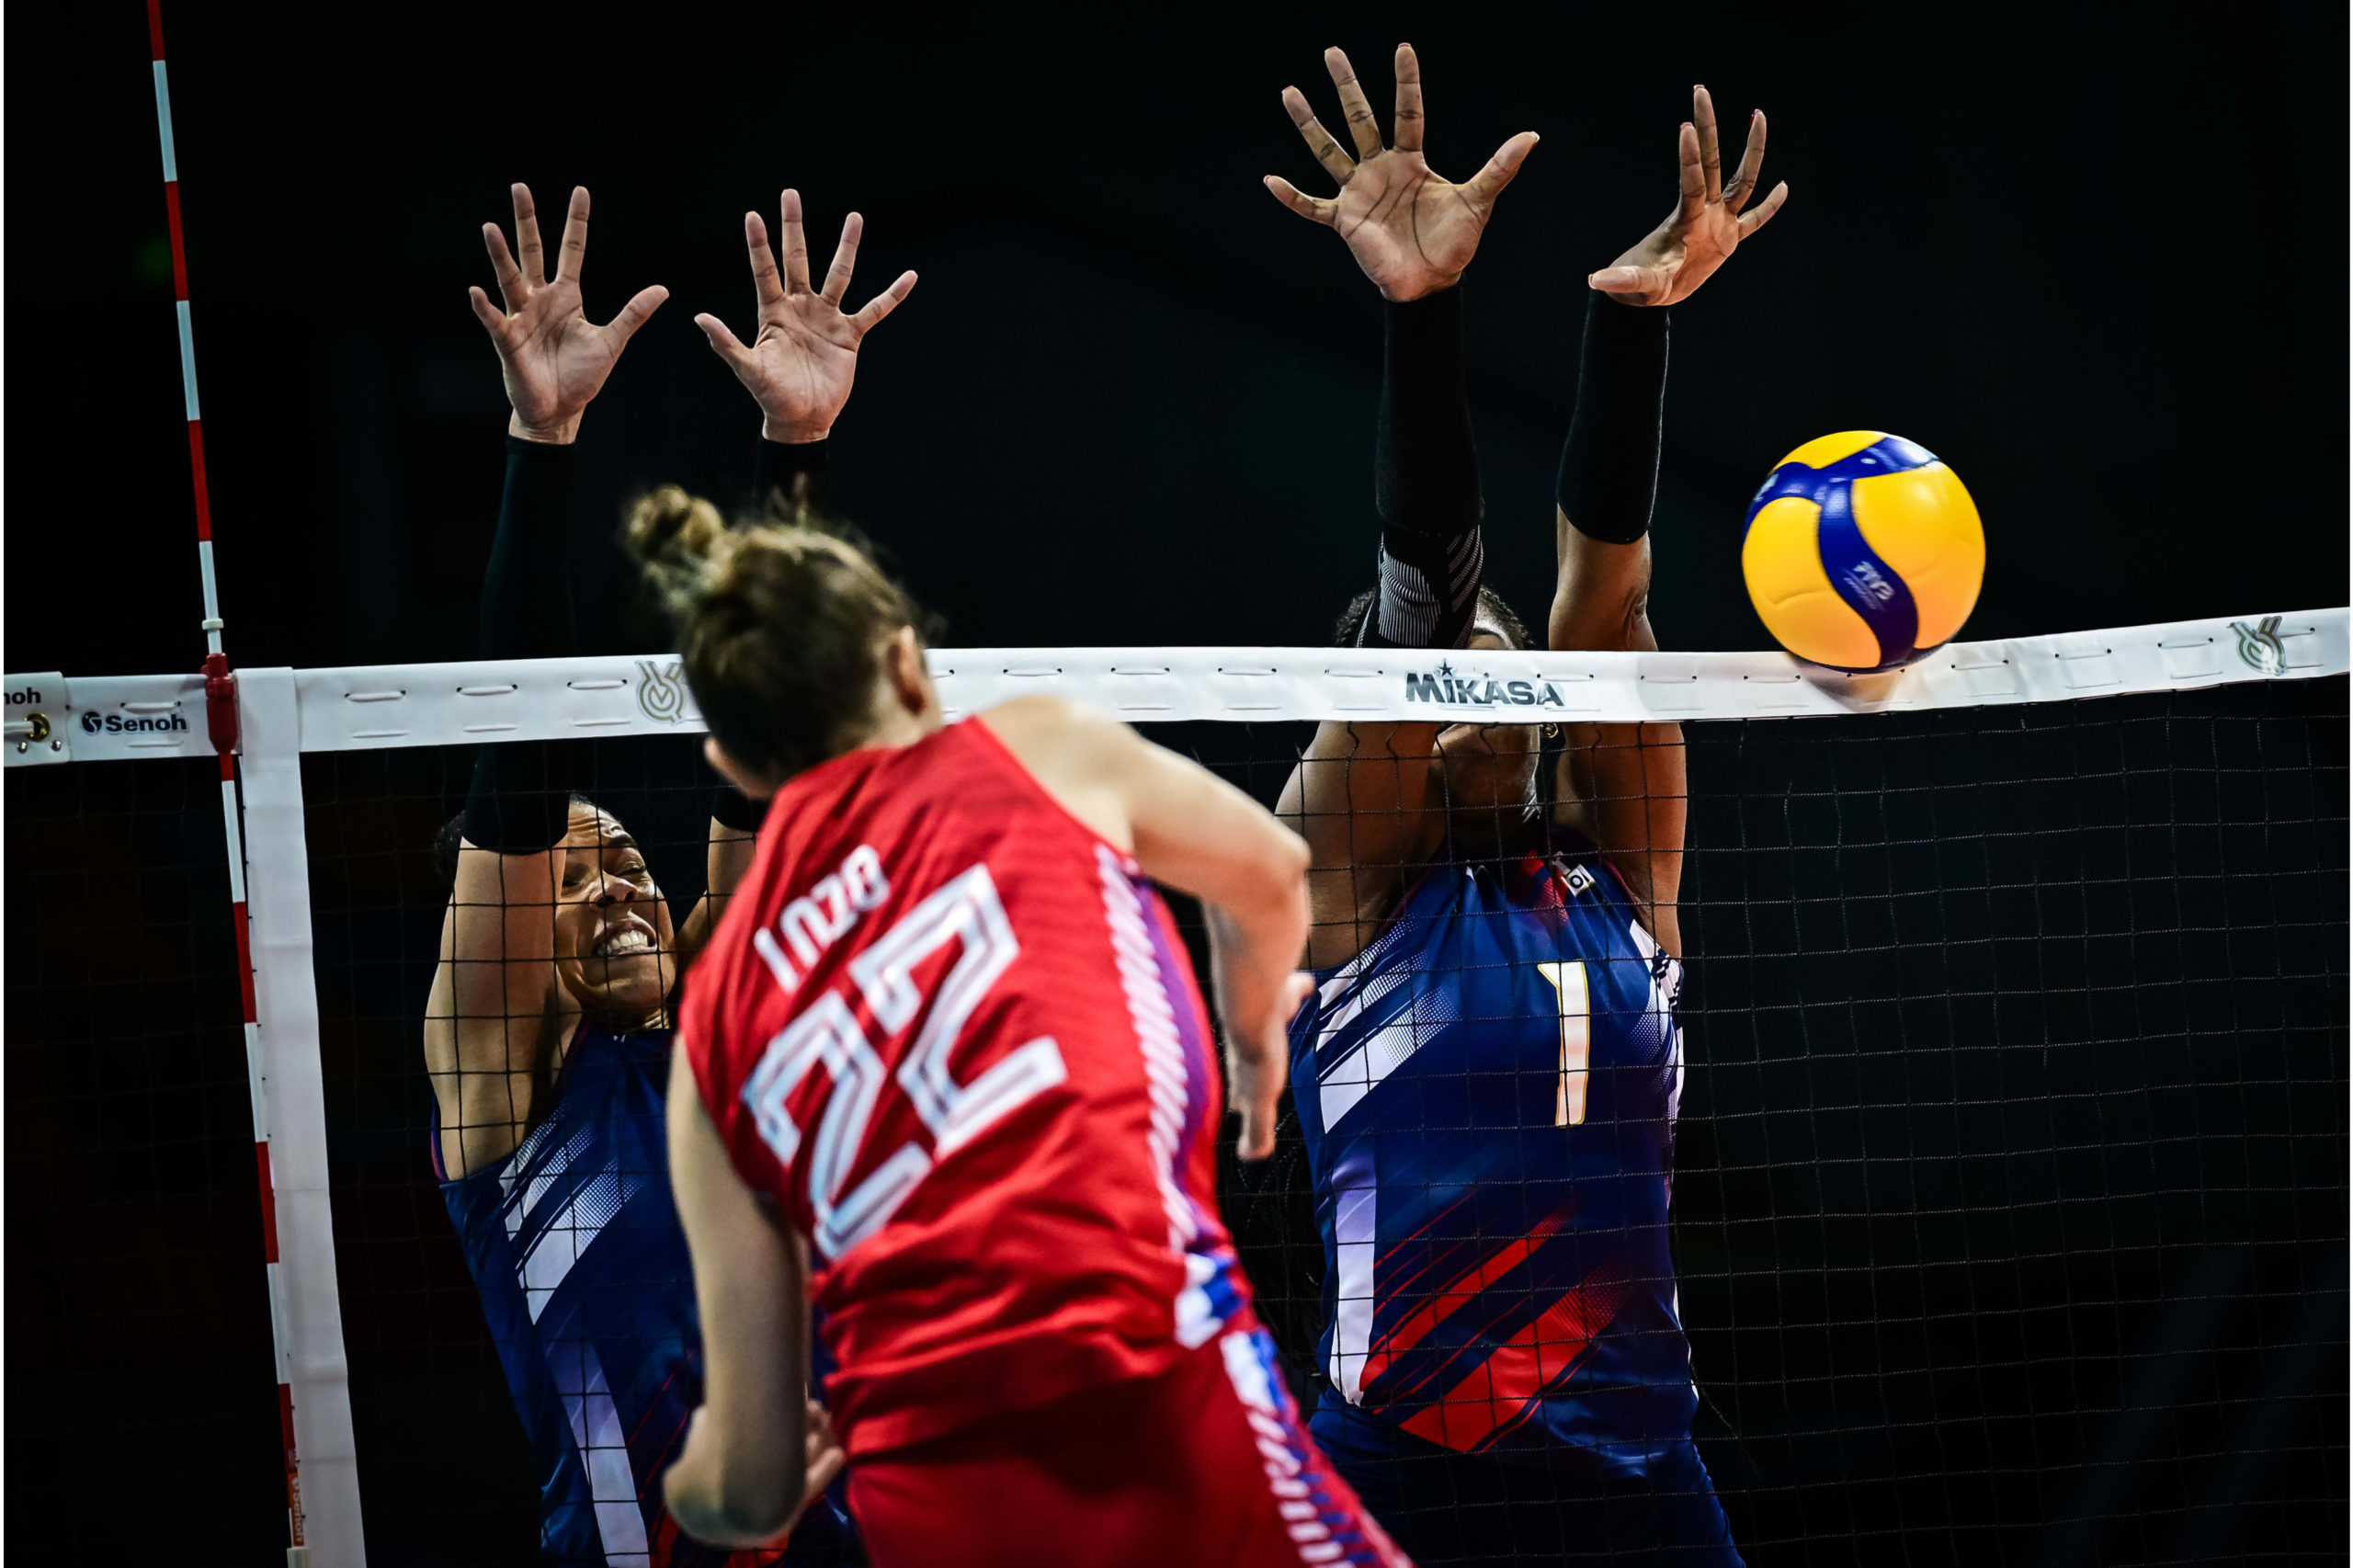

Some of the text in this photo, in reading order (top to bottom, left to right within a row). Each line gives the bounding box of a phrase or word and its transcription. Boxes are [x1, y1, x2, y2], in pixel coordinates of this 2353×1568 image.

[106, 713, 188, 733] Senoh
[740, 862, 1070, 1260] 22
[1537, 960, 1591, 1128] 1
